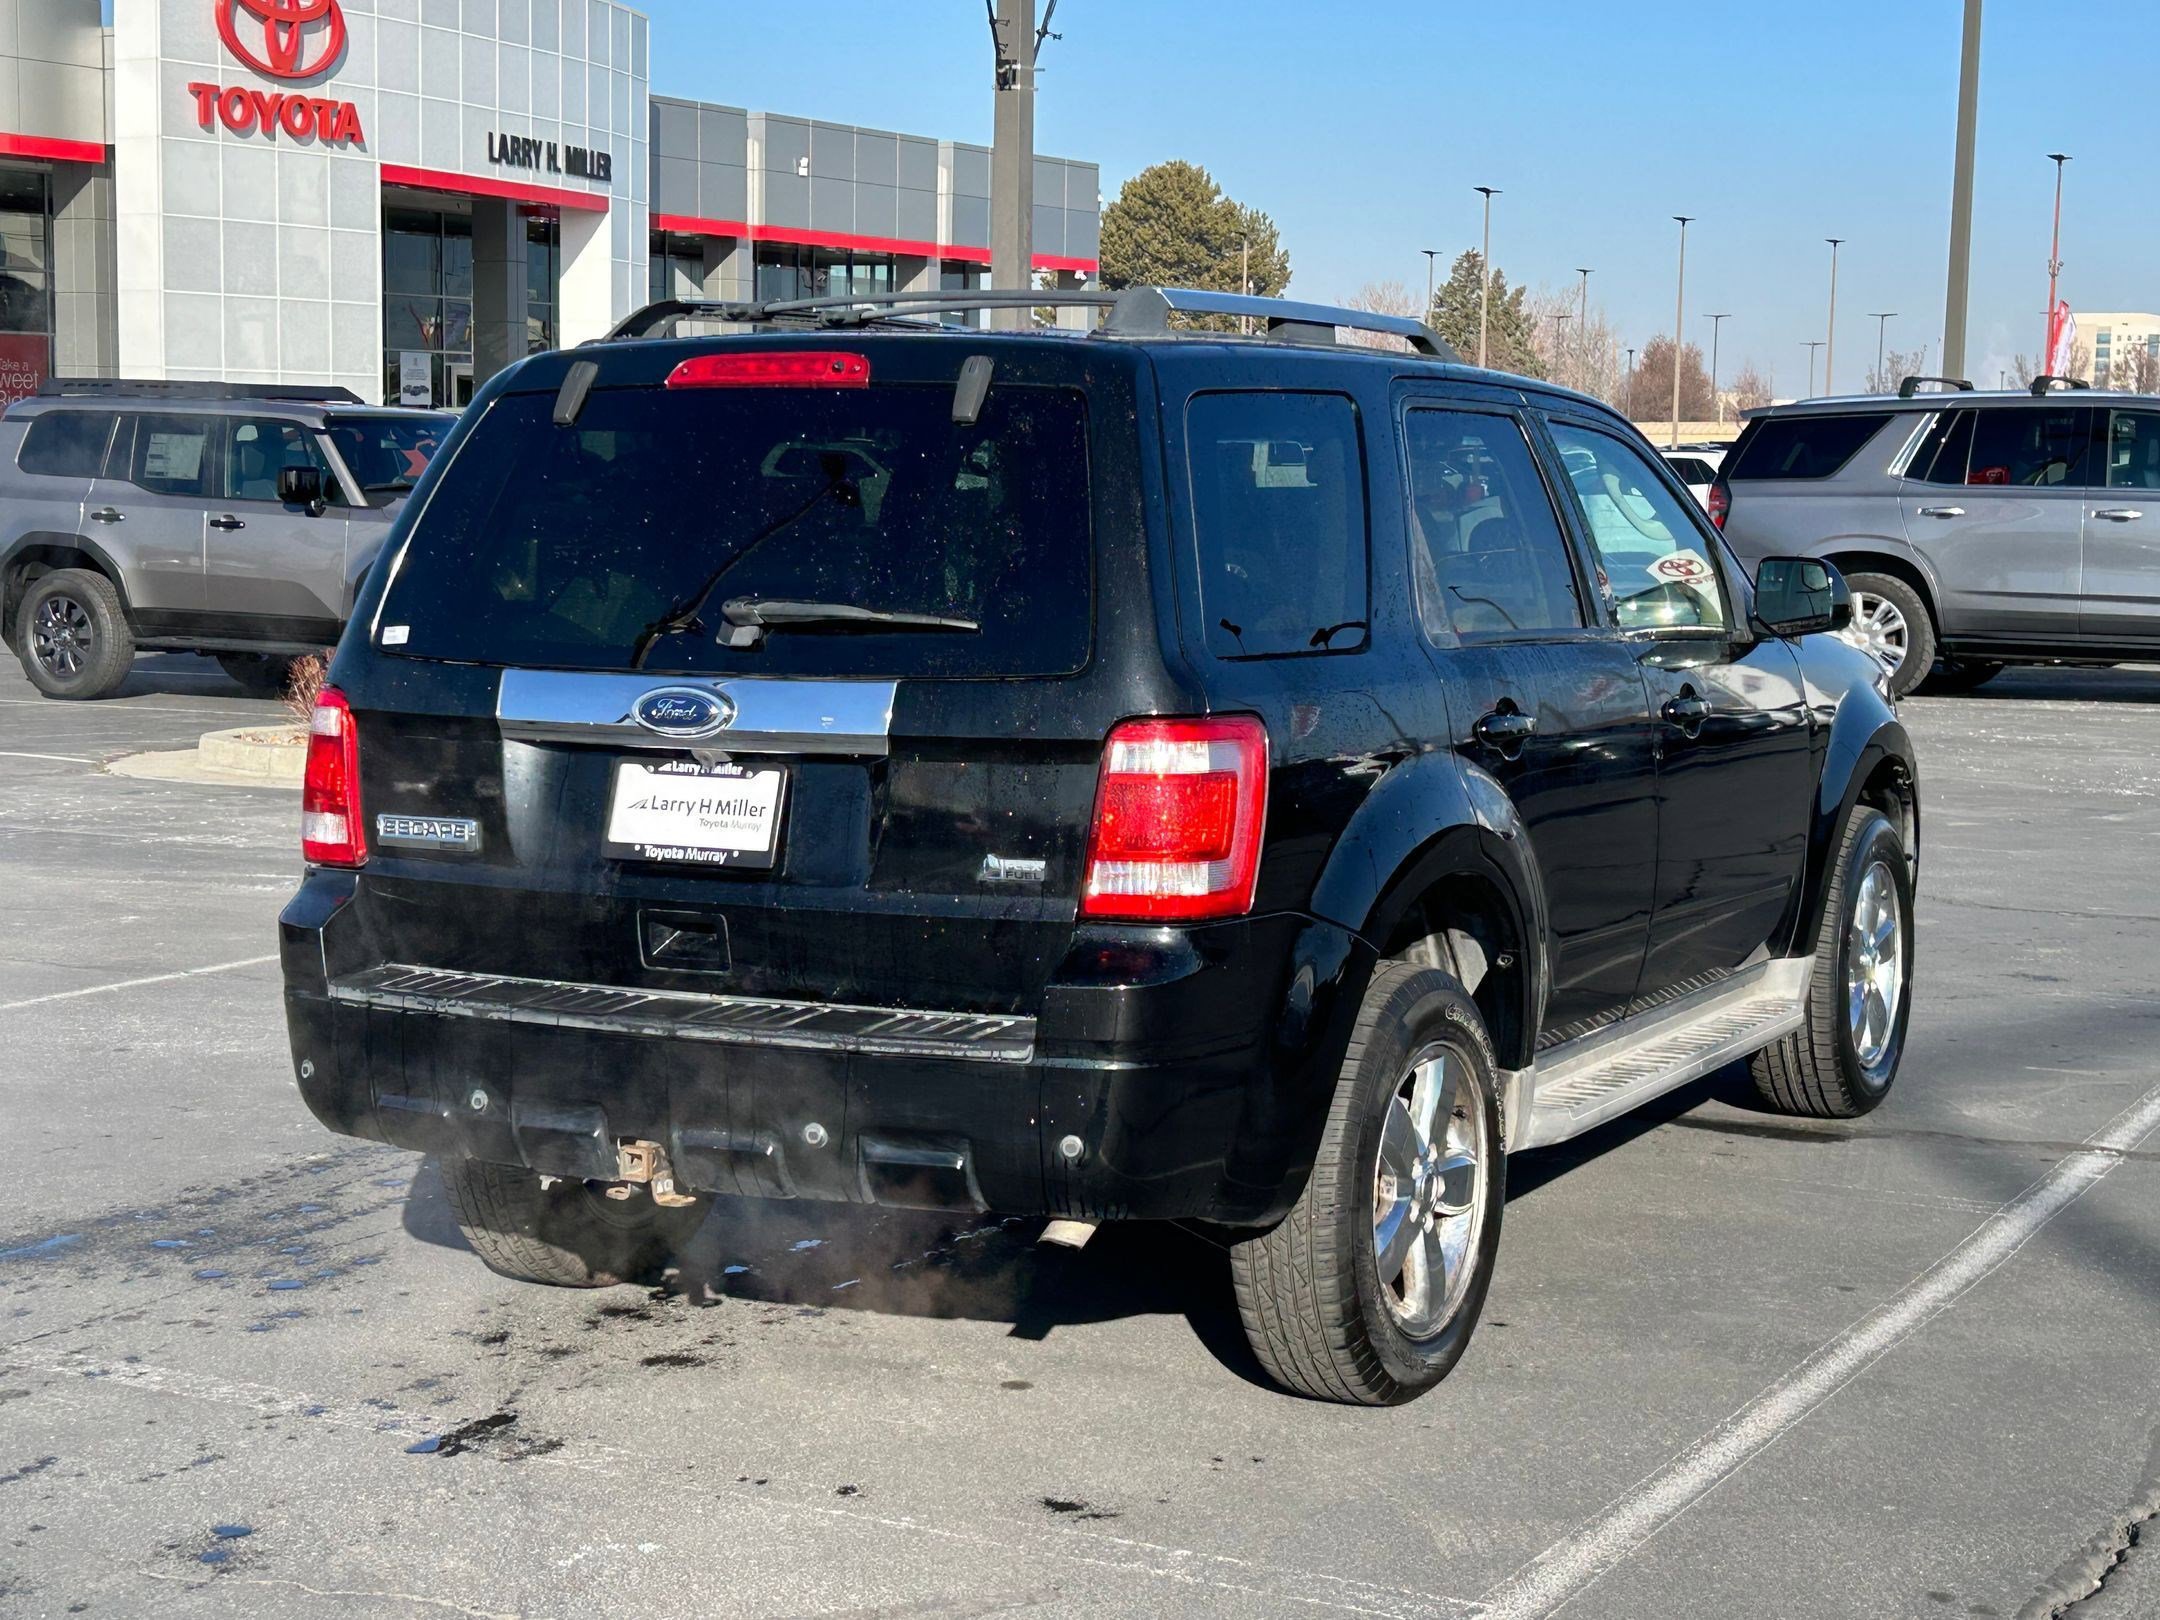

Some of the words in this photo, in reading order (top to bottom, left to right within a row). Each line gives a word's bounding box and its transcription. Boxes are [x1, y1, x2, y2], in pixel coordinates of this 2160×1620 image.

[188, 82, 363, 144] TOYOTA
[488, 131, 542, 170] LARRY
[546, 141, 561, 174] H.
[0, 358, 20, 371] ake
[22, 361, 29, 371] a
[0, 369, 39, 389] weet
[651, 698, 697, 720] Ford
[672, 760, 701, 775] Larry
[651, 795, 697, 816] Larry
[699, 798, 713, 814] H
[715, 799, 767, 818] Miller
[699, 818, 729, 829] Toyota
[731, 820, 762, 832] Murray
[644, 844, 685, 861] Toyota
[685, 847, 728, 864] Murray
[1005, 871, 1041, 880] FUEL
